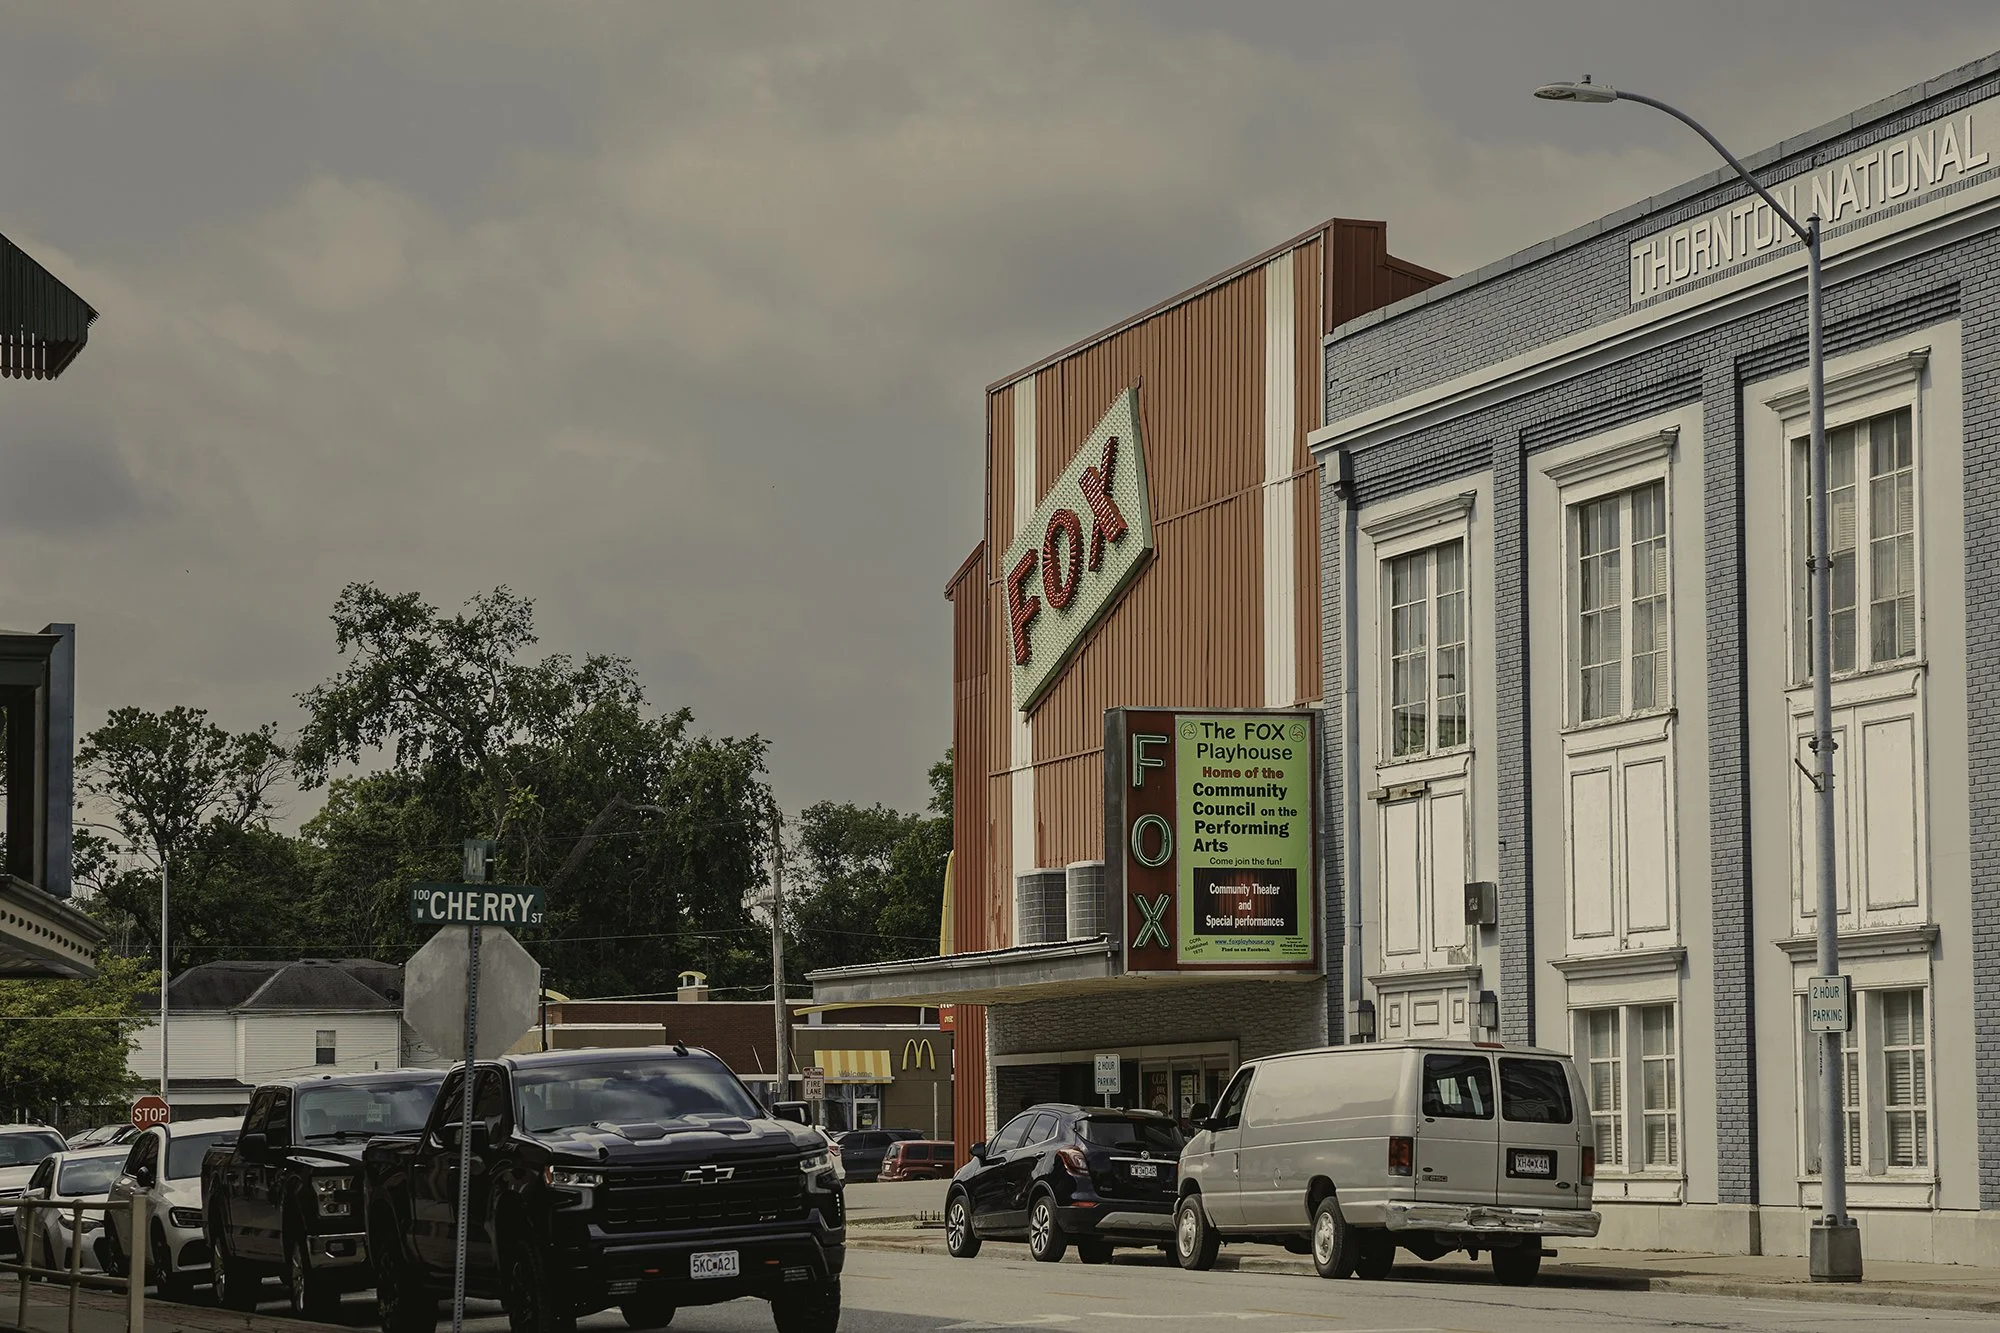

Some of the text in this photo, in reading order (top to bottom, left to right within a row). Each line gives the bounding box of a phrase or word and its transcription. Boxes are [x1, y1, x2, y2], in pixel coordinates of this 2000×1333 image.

[1633, 114, 1990, 296] THORNTON NATIONAL
[1007, 436, 1129, 666] FOX
[1200, 722, 1285, 741] The FOX
[1197, 743, 1293, 763] Playhouse
[1202, 766, 1285, 779] Home of the
[1192, 782, 1288, 801] Community
[1192, 801, 1298, 817] Council on the
[1194, 820, 1290, 838] Performing
[1132, 733, 1174, 948] FOX
[1193, 838, 1229, 852] Arts
[1209, 857, 1283, 867] Come join the fun!
[1209, 882, 1281, 897] Community Theater
[413, 889, 543, 924] 100 CHERRY ST
[1238, 899, 1252, 911] and
[1205, 914, 1285, 929] Special performances
[1813, 985, 1840, 999] 2 HOUR
[1812, 1009, 1843, 1022] PARKING
[1097, 1061, 1115, 1071] 2 HOUR
[806, 1080, 822, 1088] FIRE
[1097, 1077, 1117, 1087] PARKING
[806, 1087, 822, 1095] LANE
[133, 1107, 168, 1122] STOP
